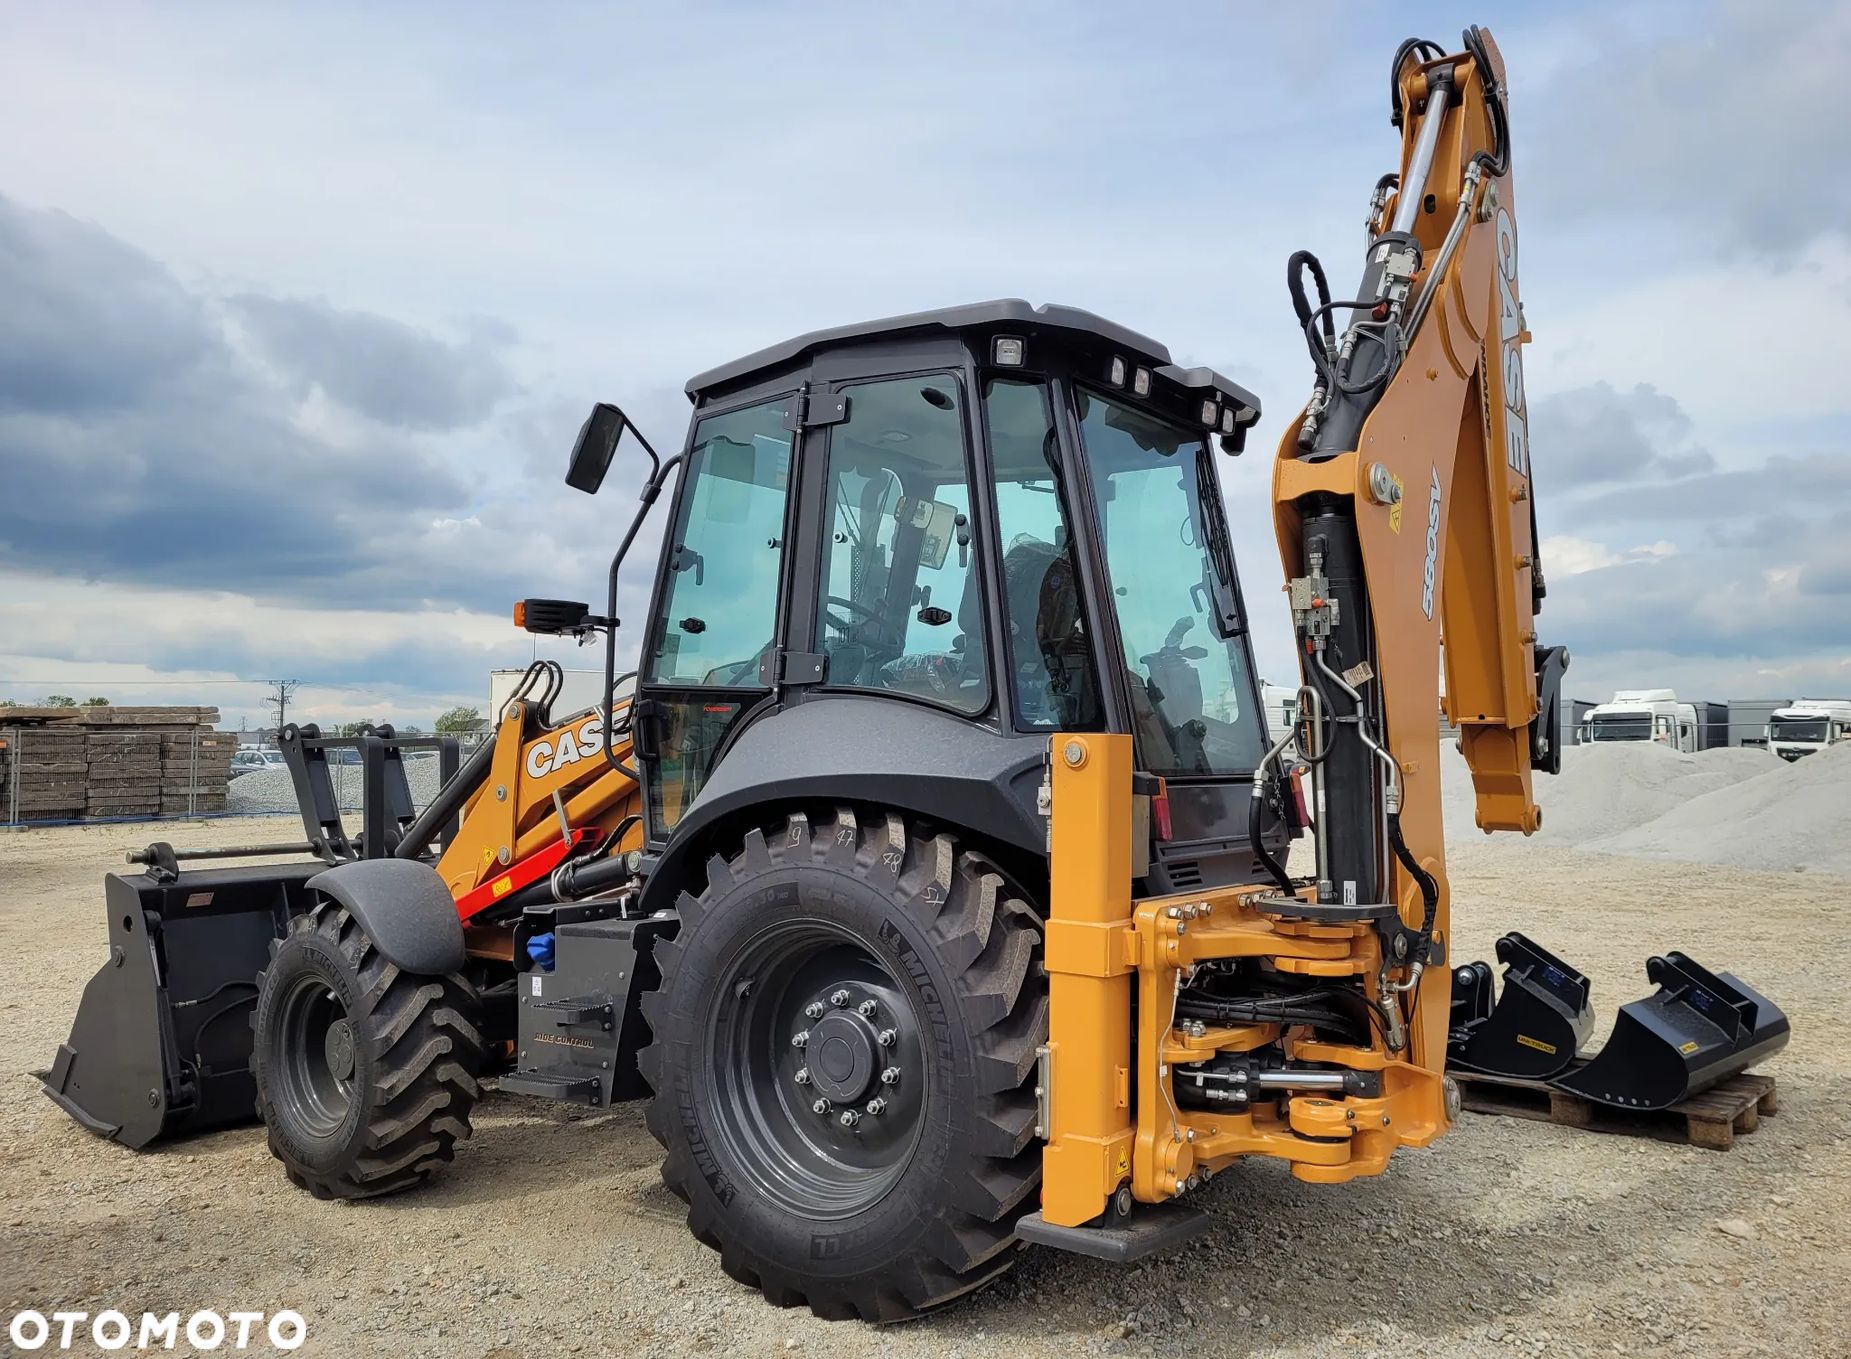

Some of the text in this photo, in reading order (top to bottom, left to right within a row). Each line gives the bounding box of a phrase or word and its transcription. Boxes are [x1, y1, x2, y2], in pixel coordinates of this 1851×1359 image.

[1496, 207, 1528, 479] CASE
[1421, 459, 1442, 622] 580SV
[534, 1032, 595, 1049] RIDE CONTROL
